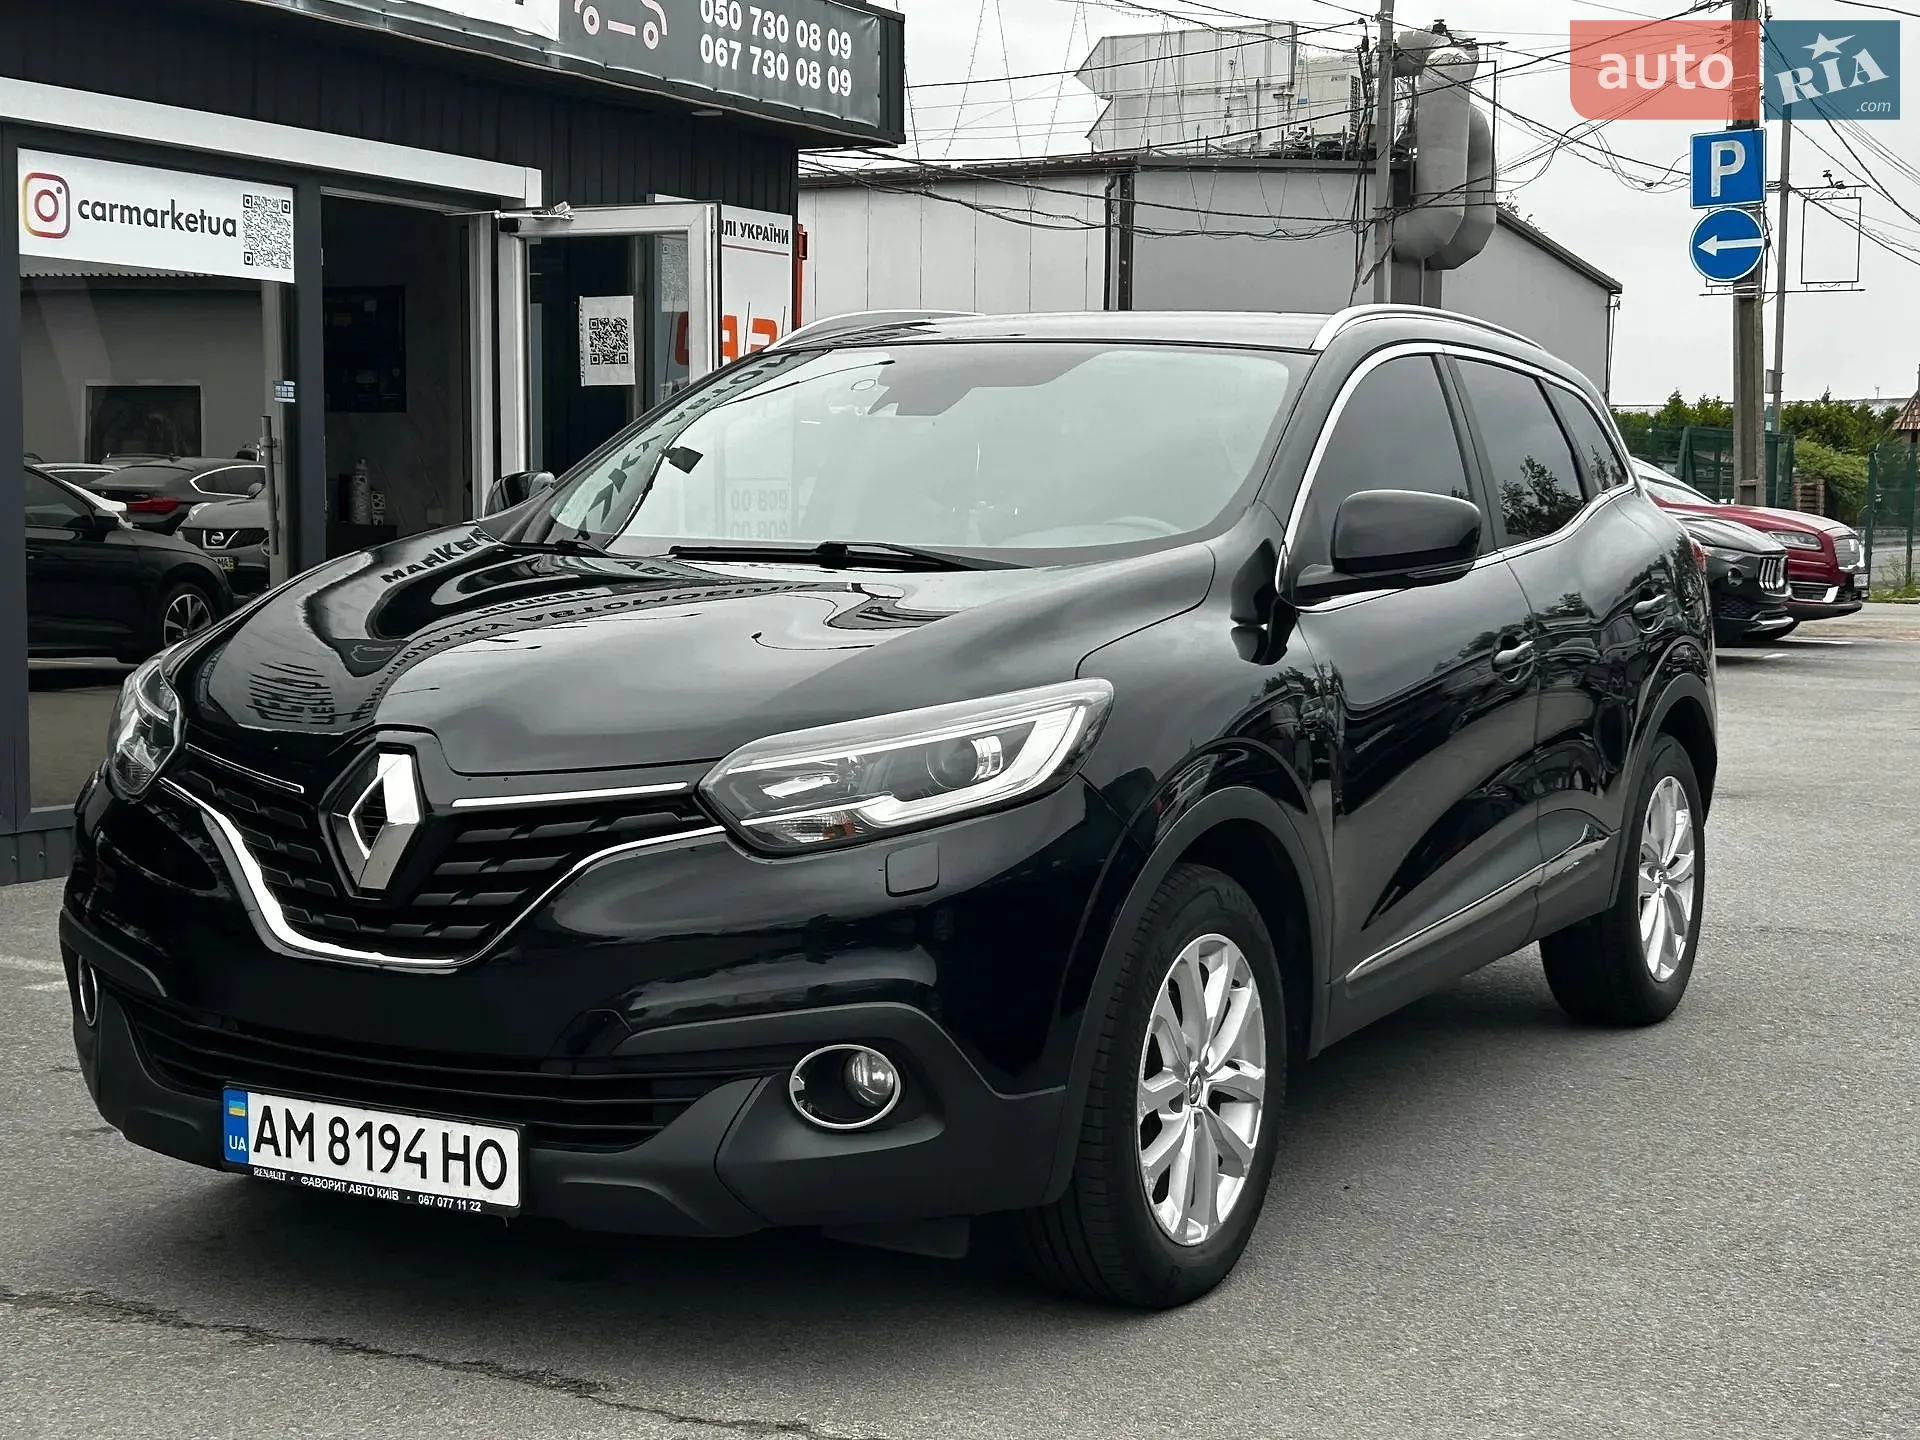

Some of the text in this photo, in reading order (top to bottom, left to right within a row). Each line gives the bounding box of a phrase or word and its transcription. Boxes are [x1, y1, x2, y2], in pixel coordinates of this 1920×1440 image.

[700, 0, 852, 59] 050 730 08 09
[700, 33, 852, 96] 067 730 08 09
[1711, 140, 1746, 197] P
[77, 199, 237, 237] carmarketua
[740, 222, 789, 245] УКРАЇНИ
[229, 1135, 247, 1152] UA
[253, 1105, 507, 1190] AM 8194 HO
[253, 1167, 482, 1212] RENAULT ФАВОРИТ АВТО КИЇВ 067 077 11 22
